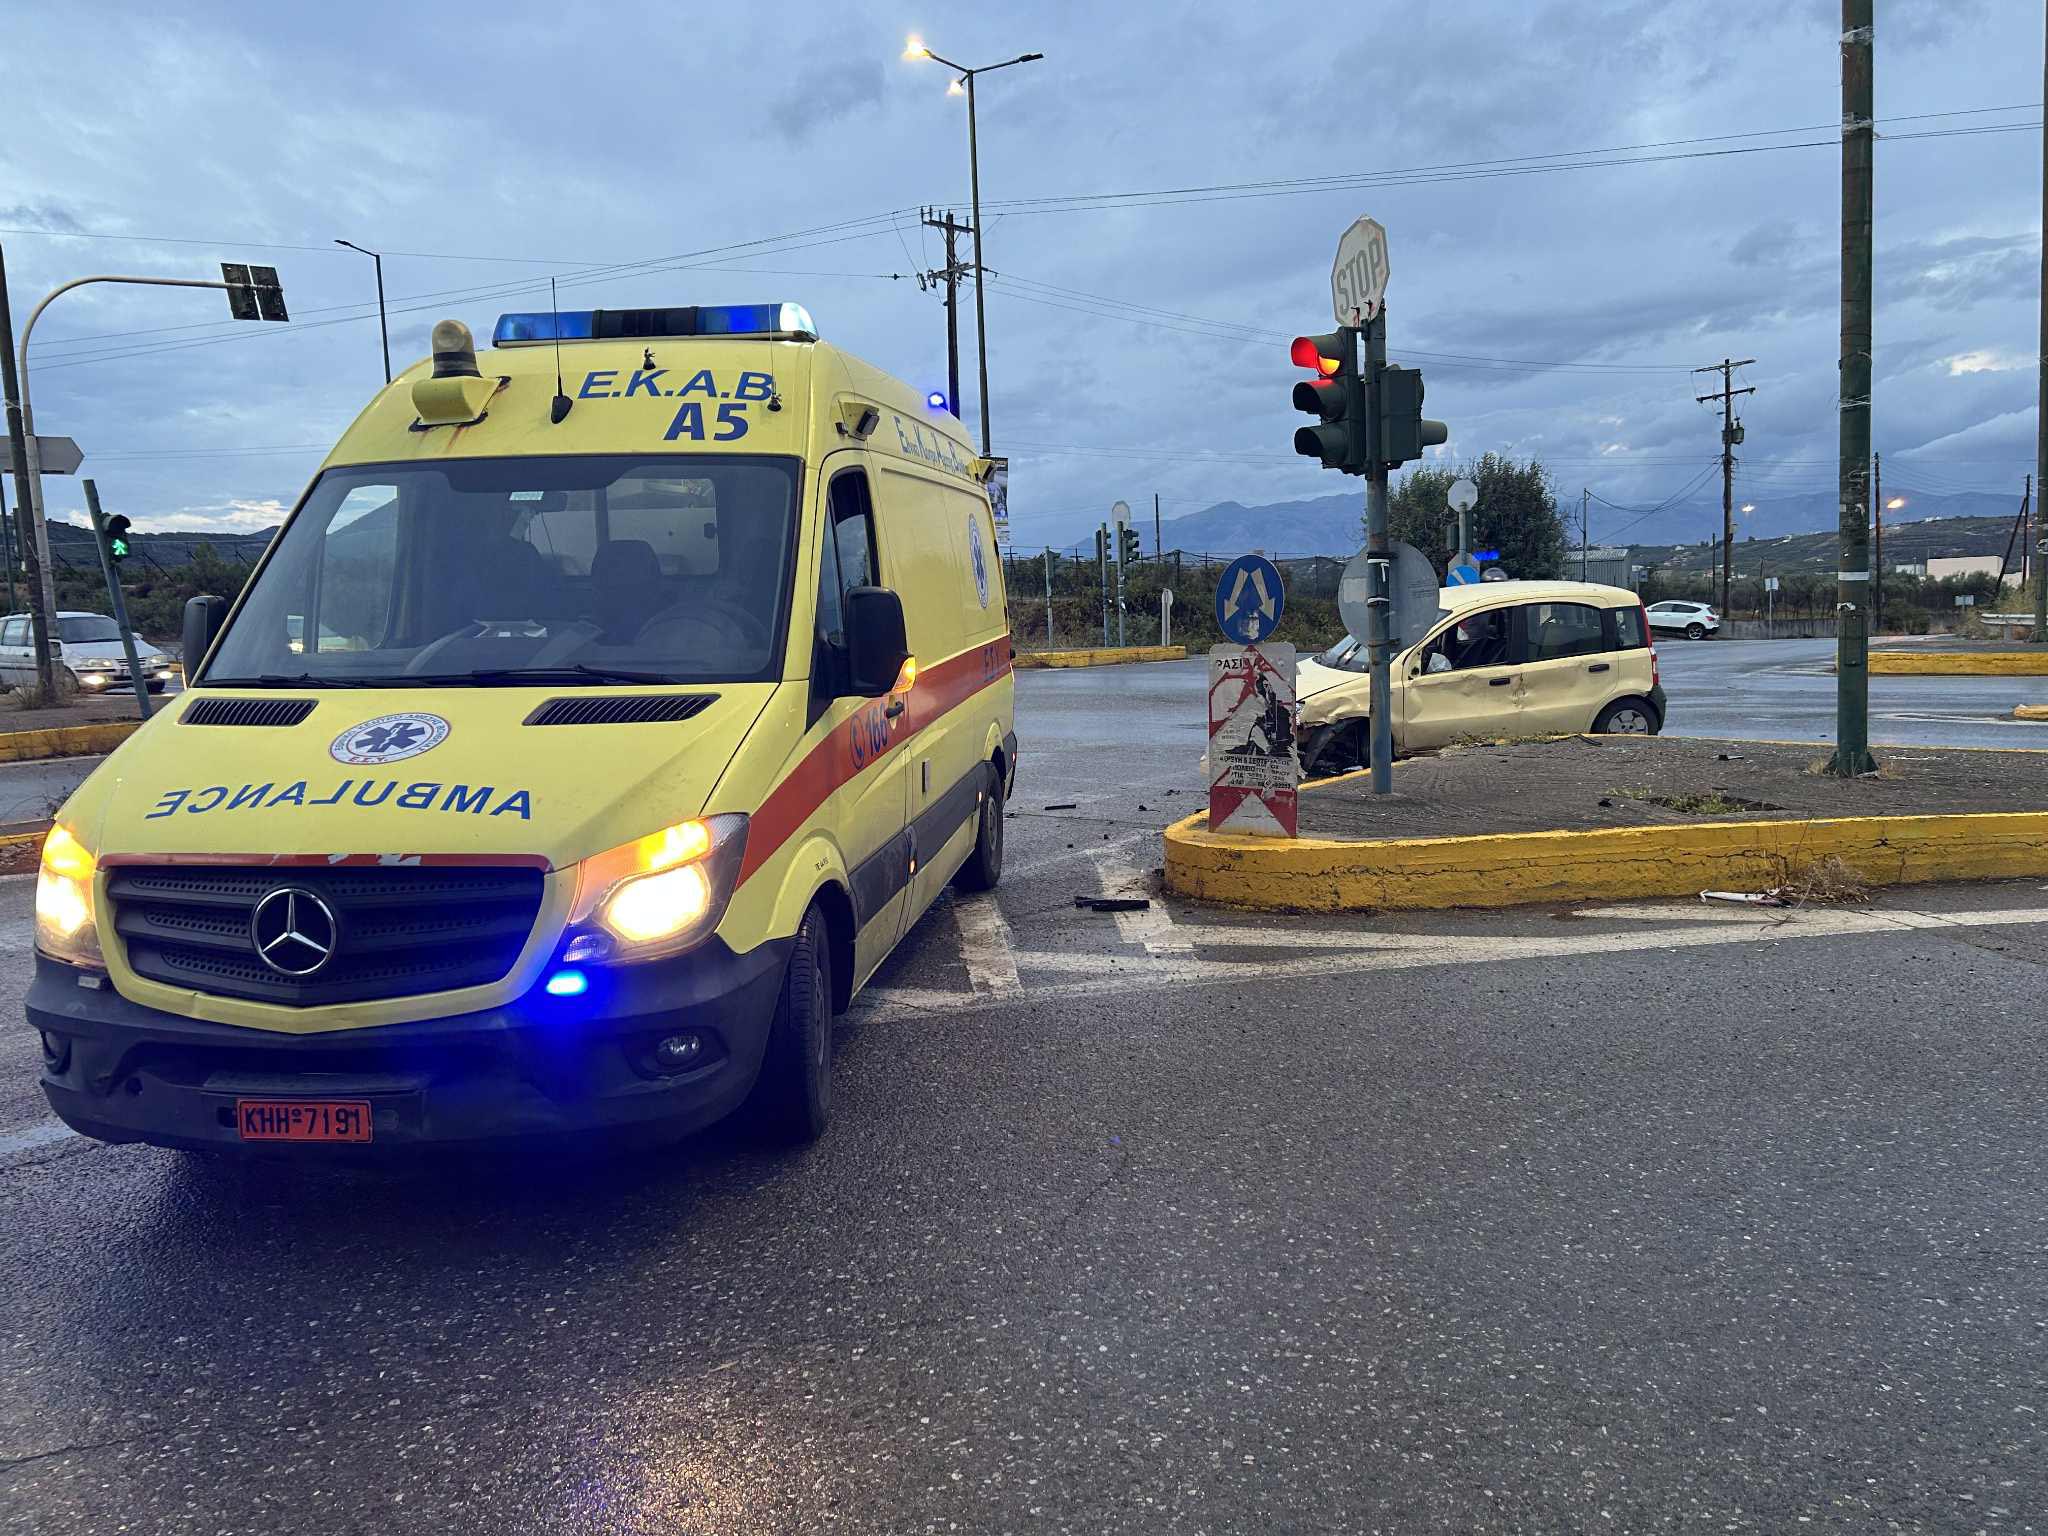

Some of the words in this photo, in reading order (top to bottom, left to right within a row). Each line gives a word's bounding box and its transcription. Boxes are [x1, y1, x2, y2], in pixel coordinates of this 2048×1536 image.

[1336, 236, 1383, 316] STOP
[663, 402, 750, 441] A5
[865, 702, 888, 756] 166
